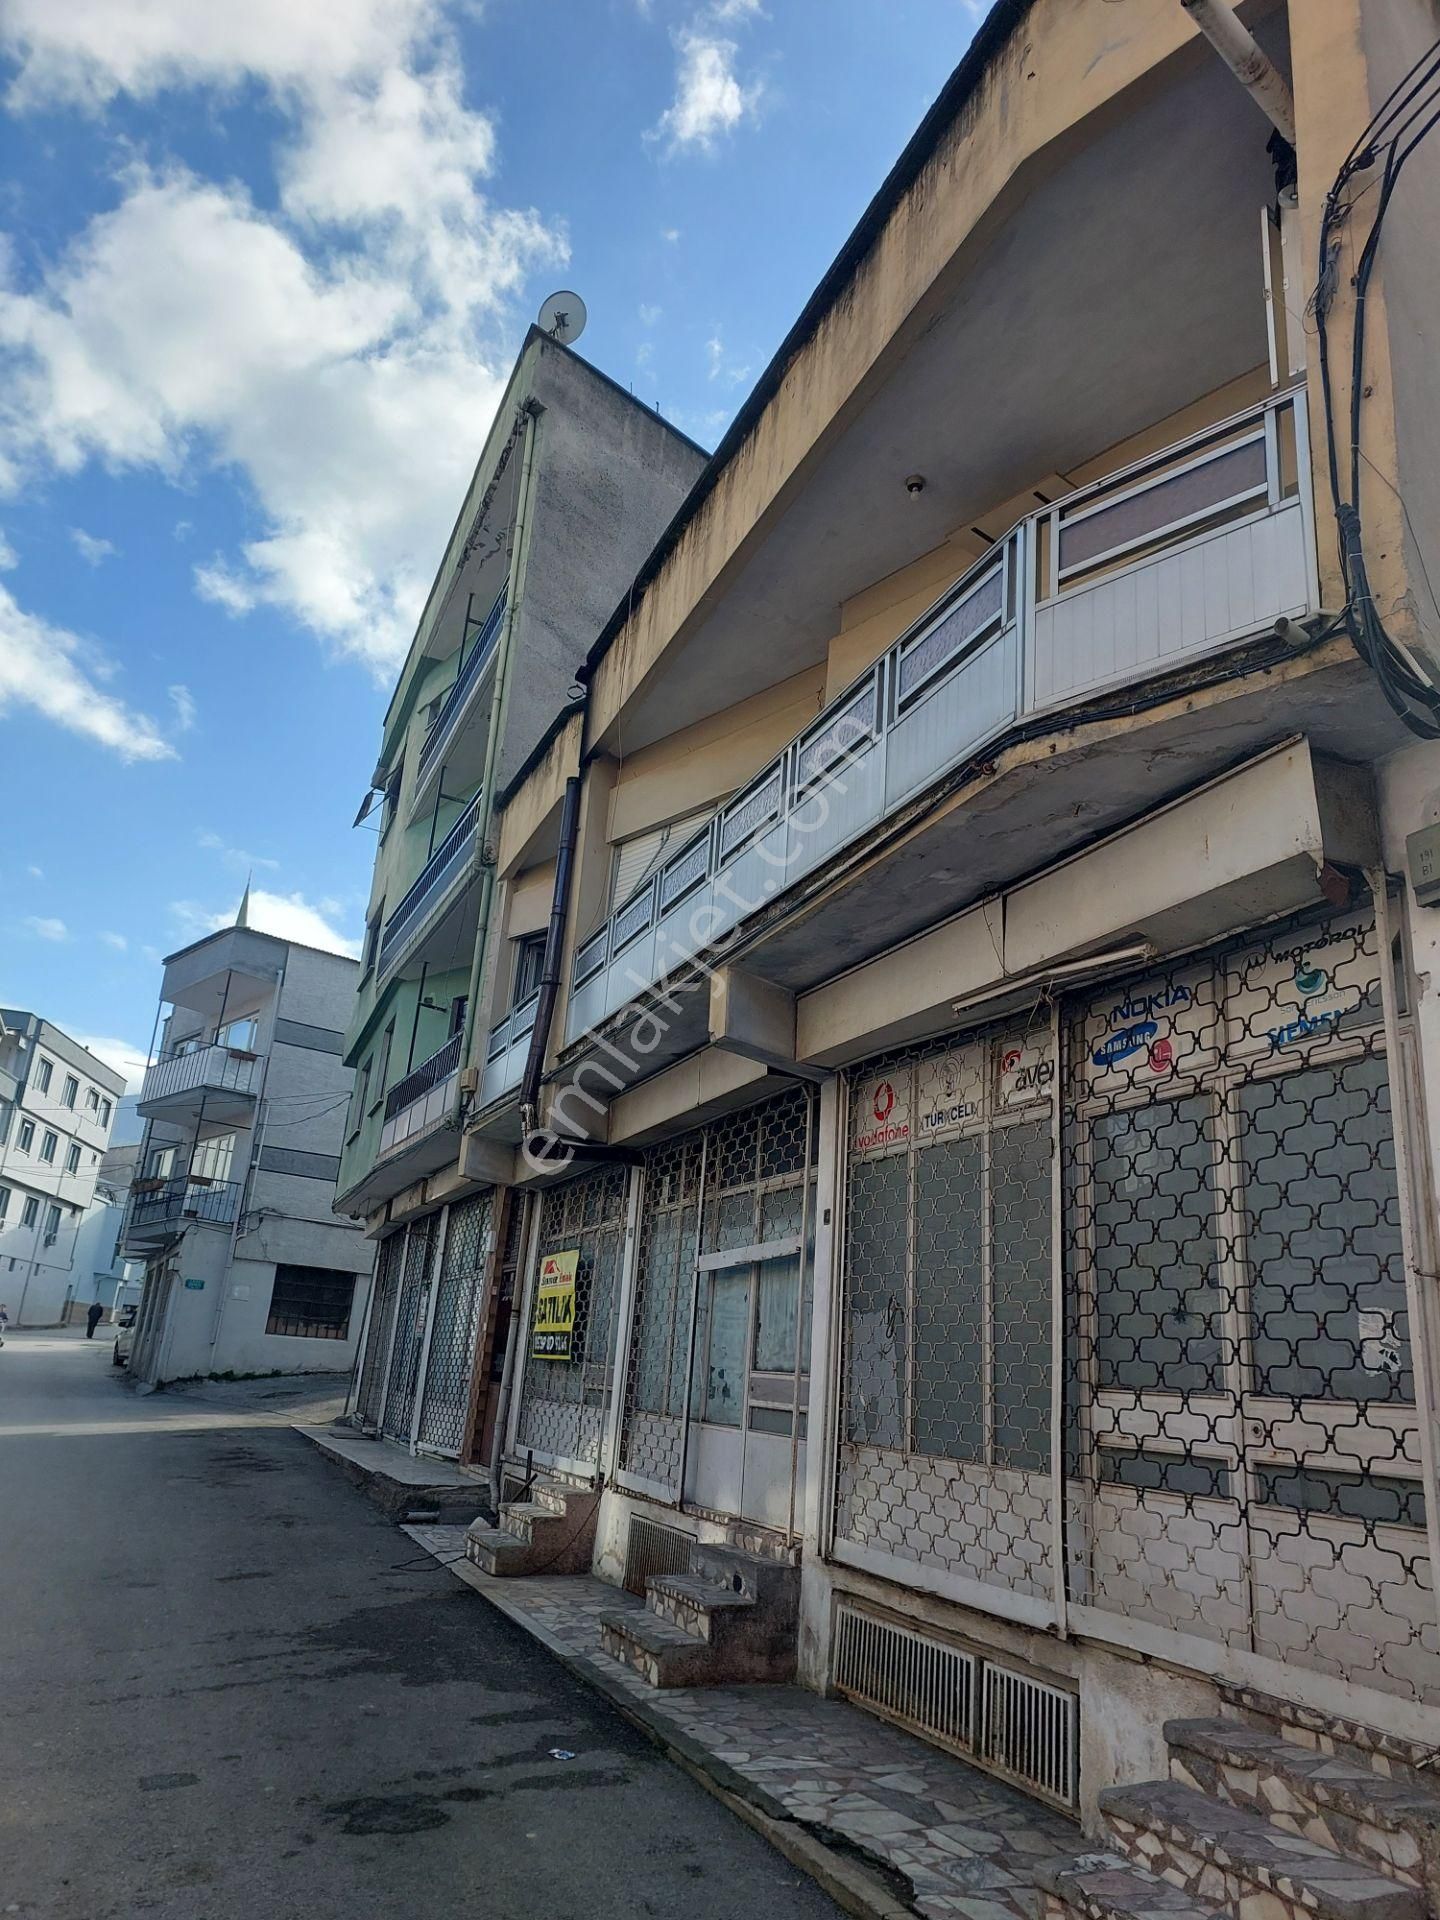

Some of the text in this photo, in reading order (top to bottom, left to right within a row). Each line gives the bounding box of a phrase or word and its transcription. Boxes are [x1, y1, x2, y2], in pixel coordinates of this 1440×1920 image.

[1113, 984, 1190, 1023] NOKIA
[1266, 1008, 1348, 1044] SIEMEN
[858, 1124, 909, 1148] vodafone
